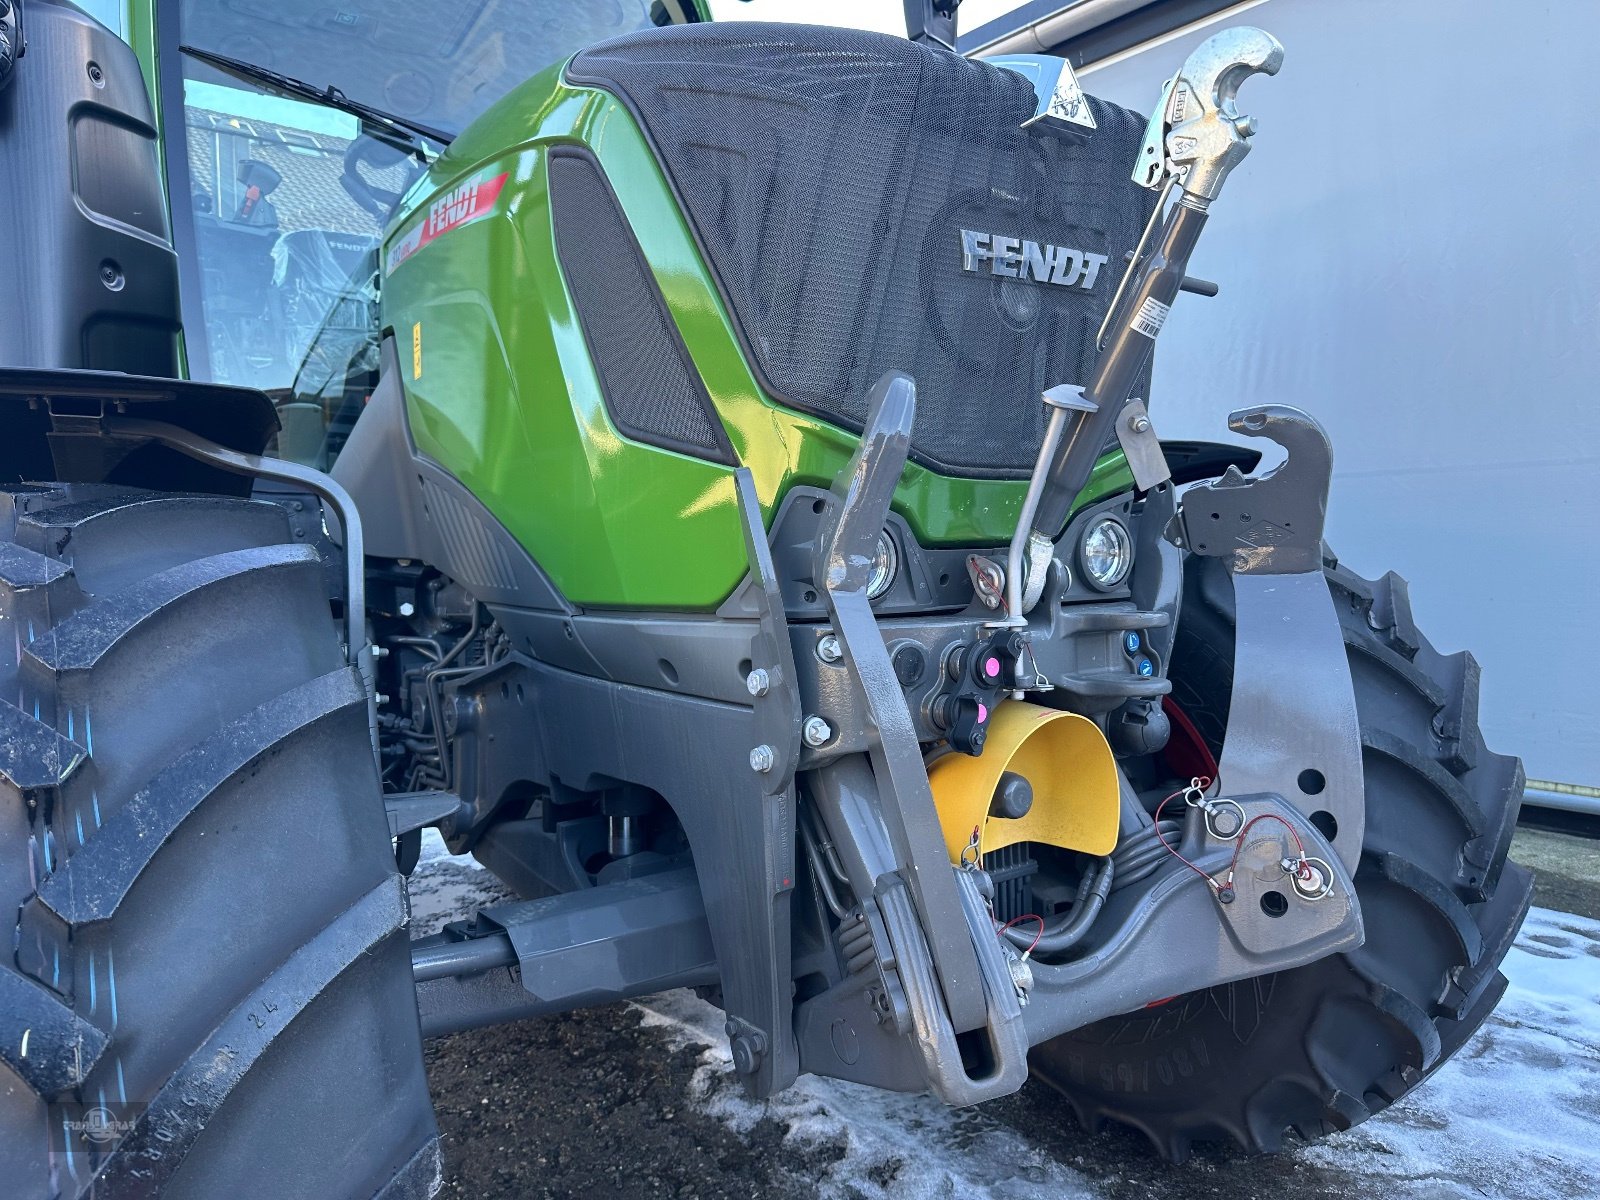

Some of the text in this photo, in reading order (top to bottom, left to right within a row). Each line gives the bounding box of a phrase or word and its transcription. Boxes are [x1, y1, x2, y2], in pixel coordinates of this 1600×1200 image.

[429, 173, 483, 237] FENDT
[329, 240, 368, 252] FENDT
[960, 228, 1109, 290] FENDT
[247, 998, 278, 1029] 24
